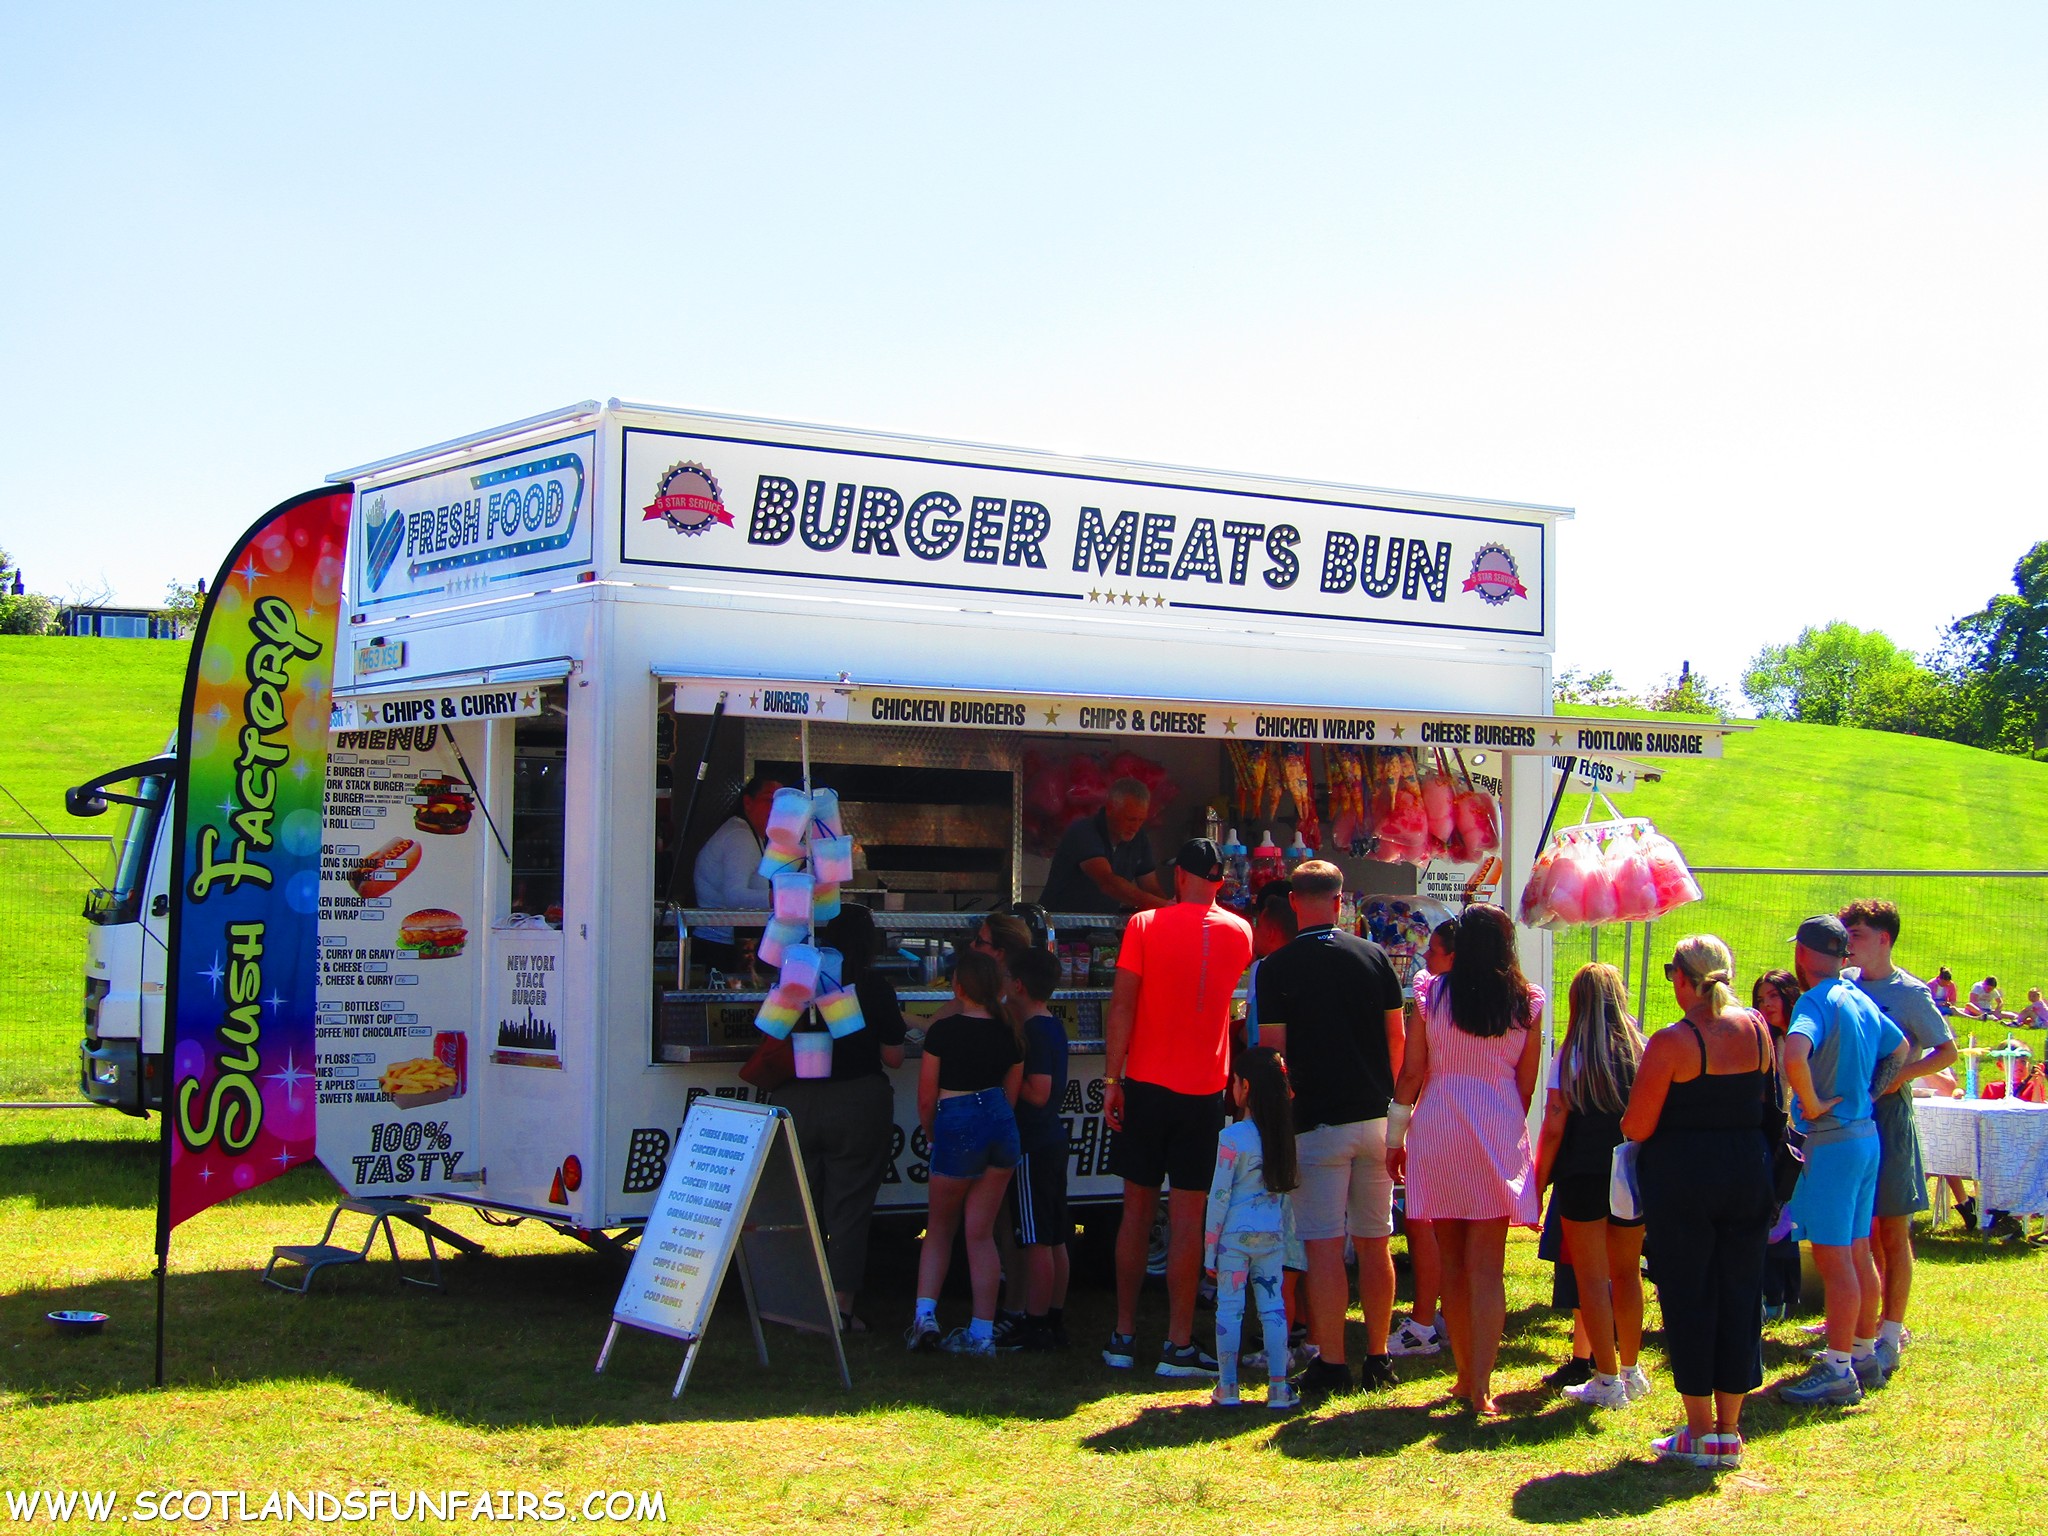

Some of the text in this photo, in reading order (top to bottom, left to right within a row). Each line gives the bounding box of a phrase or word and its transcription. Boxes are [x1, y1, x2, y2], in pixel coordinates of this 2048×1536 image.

[657, 497, 722, 514] 5 STAR SERVICE
[407, 479, 564, 558] FRESH FOOD
[748, 474, 1453, 604] BURGER MEATS BUN
[1478, 573, 1492, 581] STAR
[1493, 573, 1518, 586] SERVICE
[383, 691, 518, 723] CHIPS & CURRY
[763, 690, 810, 715] BURGERS
[871, 697, 1026, 726] CHICKEN BURGERS
[1079, 706, 1206, 734] CHIPS & CHEESE
[1255, 714, 1376, 740] CHICKEN WRAPS
[337, 725, 438, 752] MENU
[1421, 721, 1536, 747] CHEESE BURGERS
[1577, 729, 1703, 754] FOOTLONG SAUSAGE
[333, 767, 365, 777] BURGER
[1579, 759, 1614, 782] FLOSS
[326, 779, 343, 790] ORK
[346, 780, 371, 791] STACK
[373, 781, 404, 792] BURGER
[333, 792, 364, 803] BURGER
[330, 806, 361, 816] BURGER
[329, 818, 349, 829] ROLL
[342, 858, 379, 869] SAUSAGE
[1427, 883, 1453, 891] OOTLONG
[335, 897, 366, 907] BURGER
[335, 910, 359, 920] WRAP
[326, 949, 353, 959] CURRY
[355, 949, 366, 959] OR
[369, 949, 395, 959] GRAVY
[323, 962, 330, 972] &
[333, 962, 362, 973] CHEESE
[507, 955, 555, 971] NEW YORK
[325, 975, 355, 985] CHEESE
[357, 975, 364, 985] &
[367, 975, 393, 985] CURRY
[516, 972, 545, 988] STACK
[512, 989, 547, 1006] BURGER
[344, 1001, 379, 1012] BOTTLES
[349, 1014, 374, 1024] TWIST
[377, 1014, 393, 1024] CUP
[362, 1027, 407, 1038] CHOCOLATE
[325, 1054, 350, 1064] FLOSS
[324, 1080, 355, 1090] APPLES
[319, 1092, 396, 1104] SWEETS AVAILABLE
[371, 1121, 452, 1153] 100%
[699, 1128, 749, 1144] CHEESE BURGERS
[691, 1143, 745, 1161] CHICKEN BURGERS
[353, 1151, 464, 1185] TASTY
[695, 1161, 729, 1176] HOT DOGS
[681, 1176, 731, 1194] CHICKEN WRAPS
[668, 1190, 733, 1212] FOOT LONG SAUSAGE
[667, 1207, 722, 1228] GERMAN SAUSAGE
[678, 1228, 697, 1240] CHIPS
[659, 1240, 705, 1259] CHIPS & CURRY
[652, 1256, 700, 1276] CHIPS & CHEESE
[660, 1276, 679, 1289] SLUSH
[643, 1290, 684, 1308] COLD DRINKS
